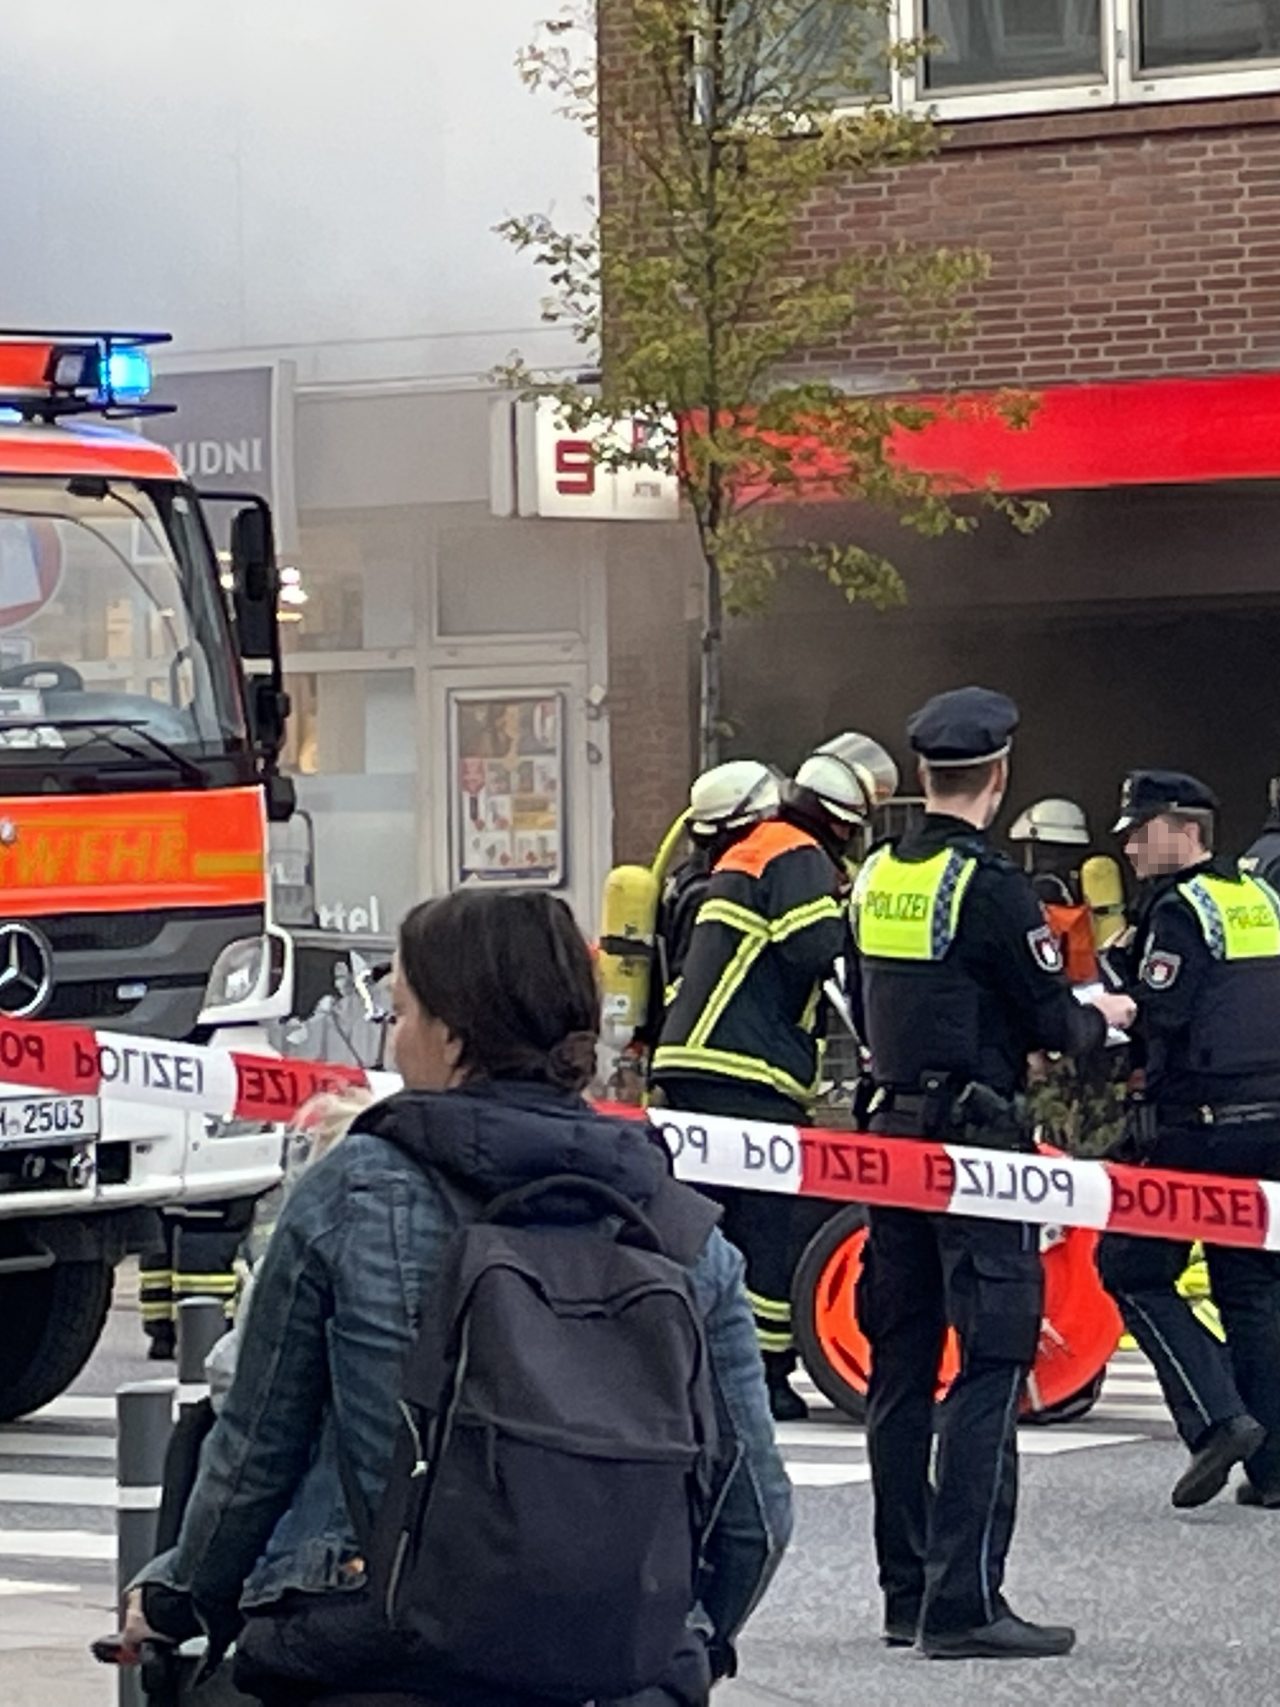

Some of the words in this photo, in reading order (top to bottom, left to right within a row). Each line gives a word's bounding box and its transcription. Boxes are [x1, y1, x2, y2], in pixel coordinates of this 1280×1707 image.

[174, 438, 262, 476] UDNI
[0, 828, 188, 885] WEHR
[864, 890, 931, 922] POLIZEI
[22, 1099, 84, 1134] 2503
